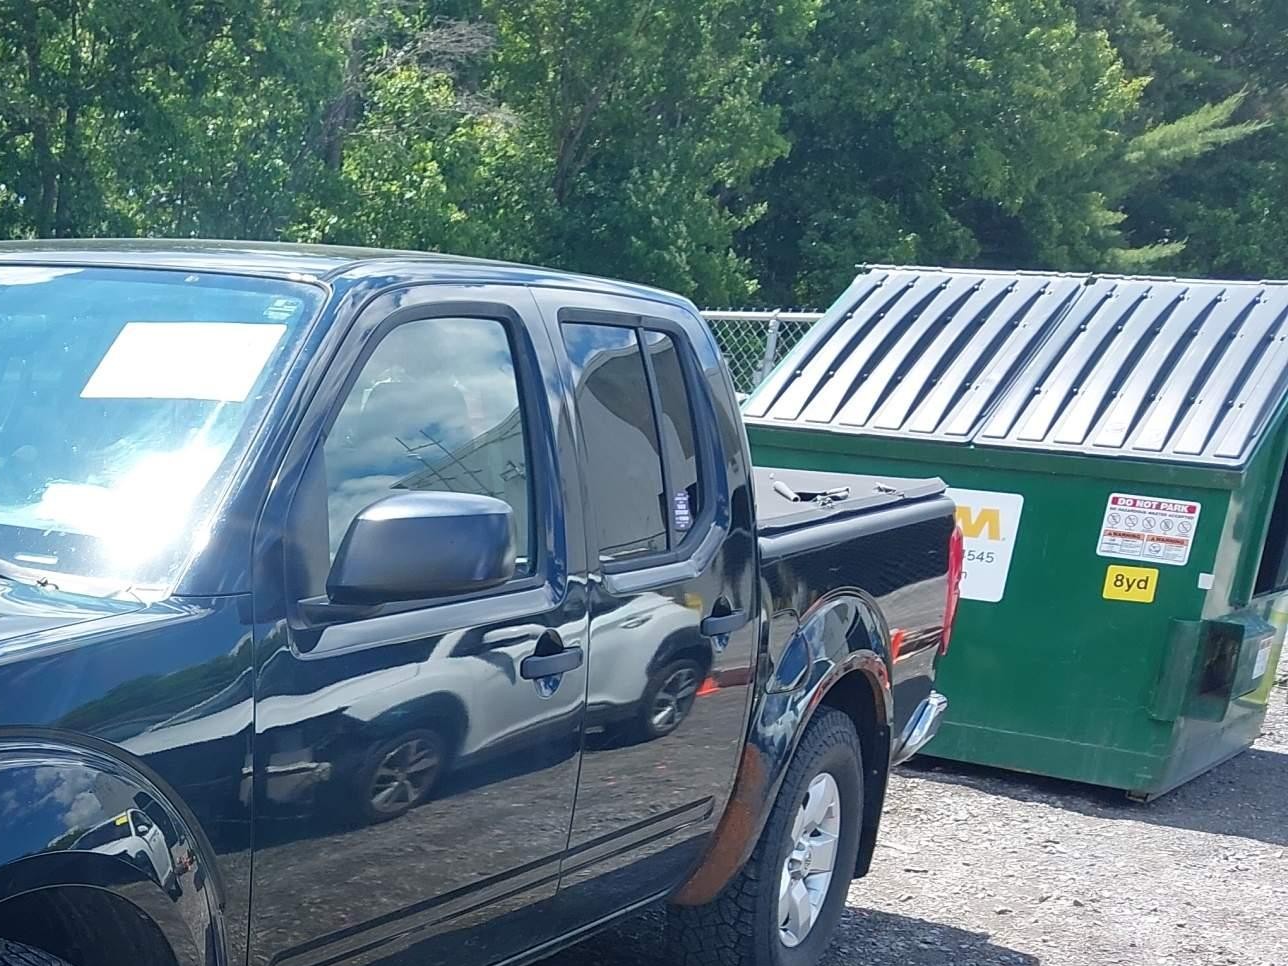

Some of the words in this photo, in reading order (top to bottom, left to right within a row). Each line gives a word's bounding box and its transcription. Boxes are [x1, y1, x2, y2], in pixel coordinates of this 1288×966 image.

[1117, 498, 1133, 506] DO
[1136, 499, 1160, 509] NOT
[1160, 502, 1189, 513] PARK
[1113, 573, 1149, 592] 8yd
